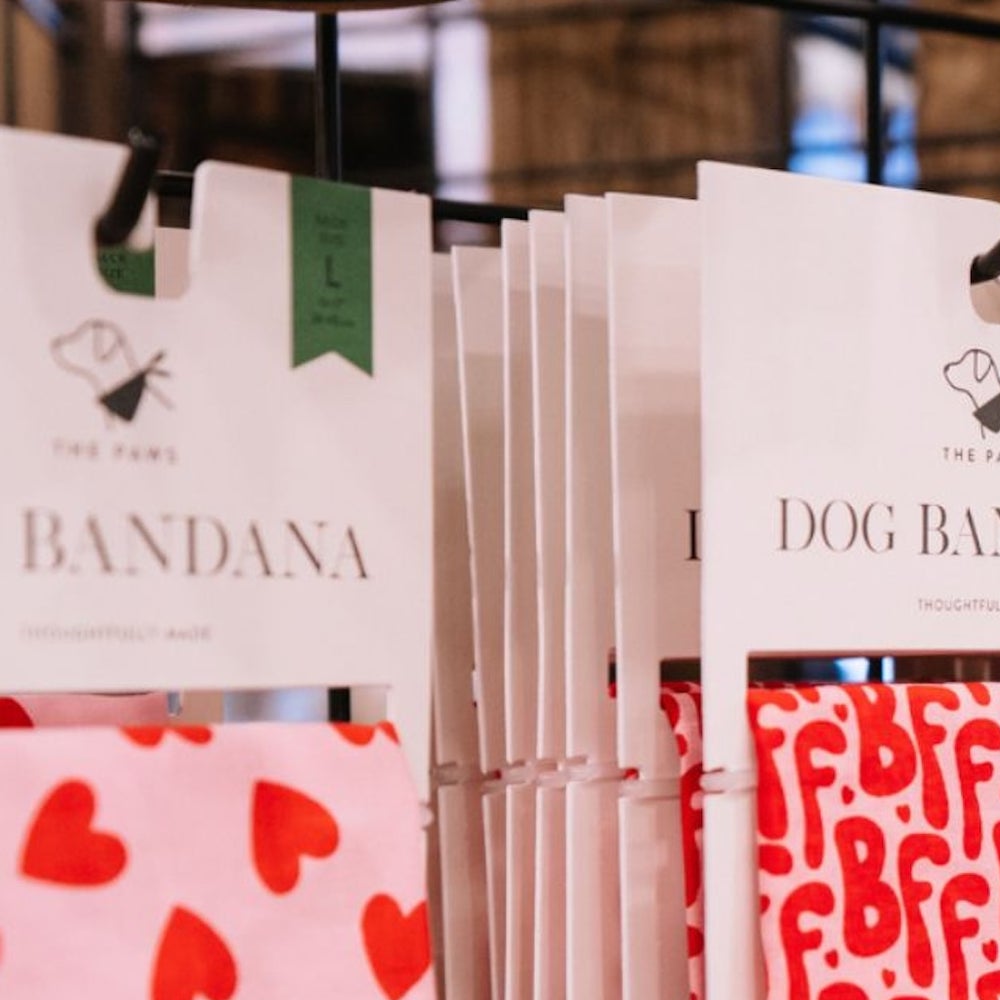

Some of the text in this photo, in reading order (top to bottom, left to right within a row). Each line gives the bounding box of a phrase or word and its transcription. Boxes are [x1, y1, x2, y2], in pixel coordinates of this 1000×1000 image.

[325, 254, 341, 288] L
[943, 447, 976, 462] THE
[22, 505, 369, 580] BANDANA
[777, 498, 895, 554] DOG
